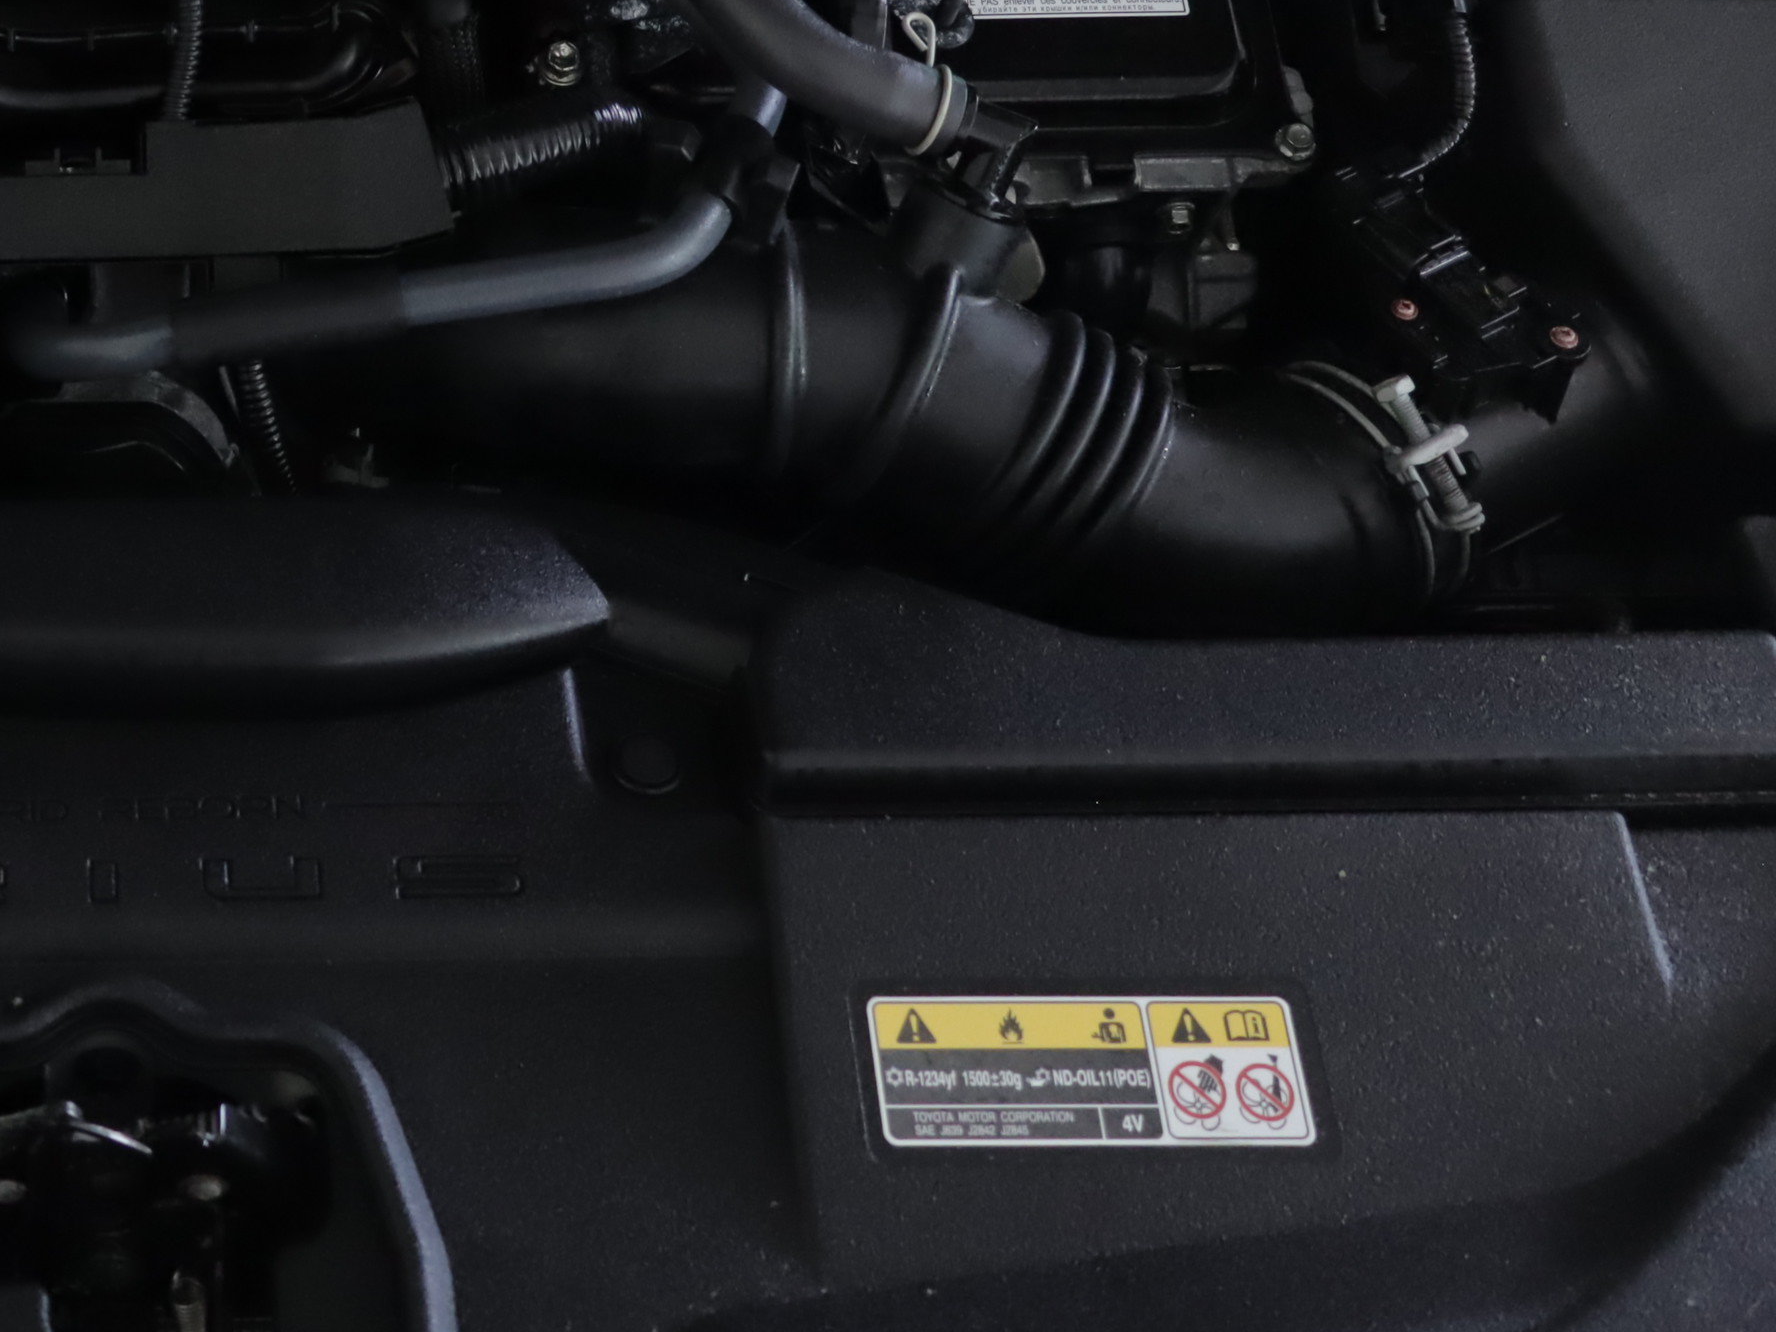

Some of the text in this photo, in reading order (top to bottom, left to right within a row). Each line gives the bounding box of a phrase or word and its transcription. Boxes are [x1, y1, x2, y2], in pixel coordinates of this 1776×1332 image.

[99, 794, 307, 823] REBORN
[904, 1068, 1152, 1091] R-1234yf 1500±30g ND-OIL11(POE)
[912, 1110, 1075, 1123] TOYOTA MOTOR CORPORATION
[1121, 1113, 1144, 1133] 4V
[913, 1124, 936, 1137] SAE
